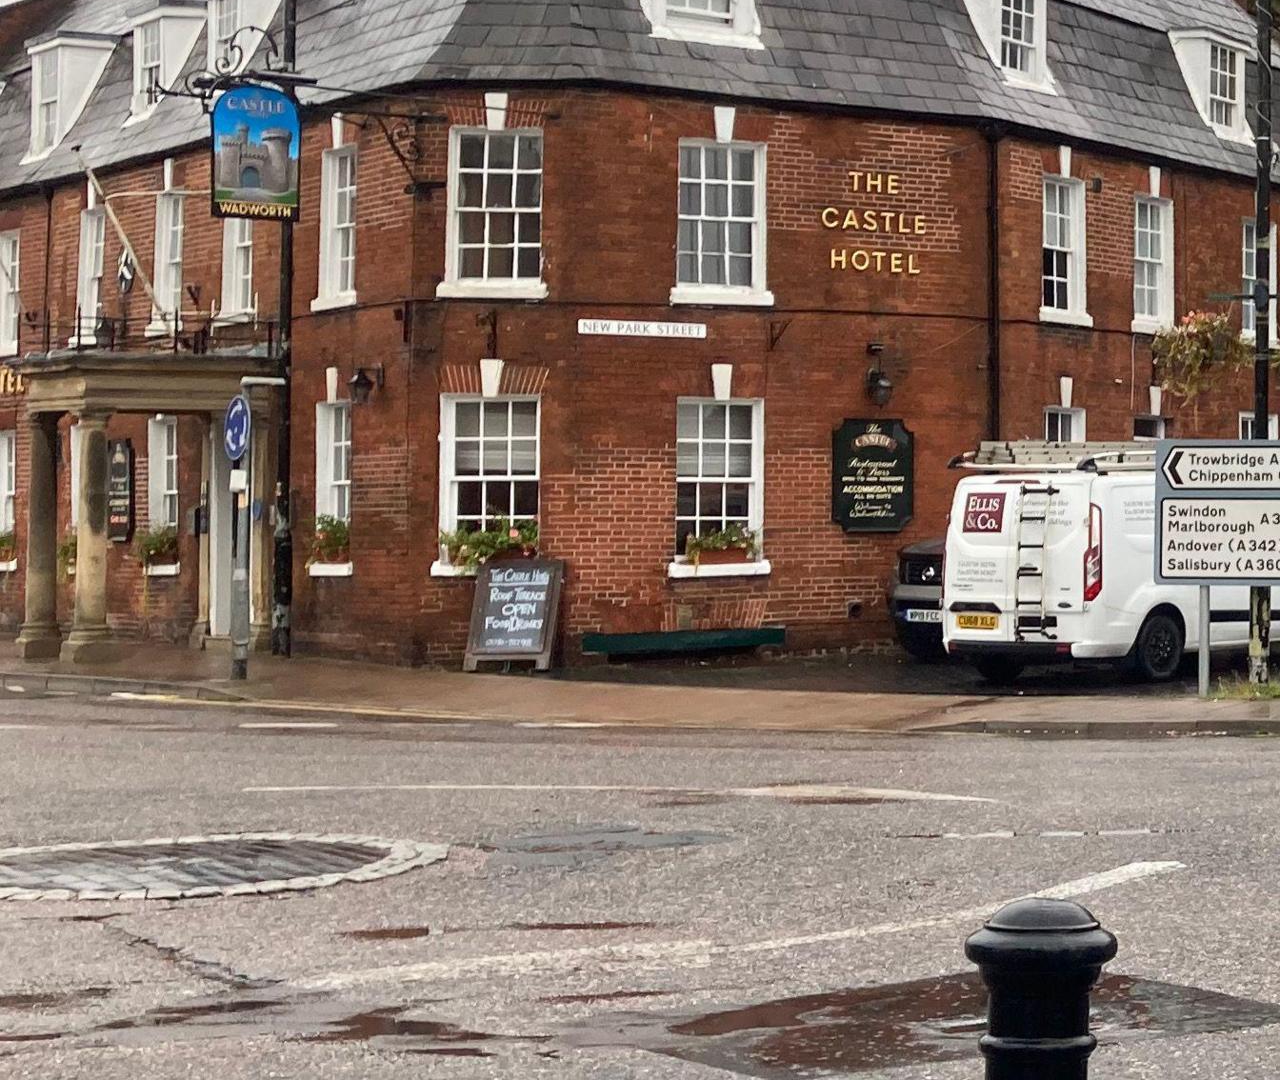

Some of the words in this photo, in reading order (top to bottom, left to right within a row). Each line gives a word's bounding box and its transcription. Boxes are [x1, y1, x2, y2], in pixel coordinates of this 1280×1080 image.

[848, 171, 900, 194] THE
[219, 202, 291, 217] WADWORTH
[821, 207, 926, 234] CASTLE
[830, 248, 921, 274] HOTEL
[582, 322, 611, 332] NEW
[617, 323, 650, 334] PARK
[656, 324, 702, 336] STREET
[1188, 453, 1265, 467] Trowbridge
[1188, 469, 1273, 483] Chippenham
[842, 485, 904, 493] ACCOMMODATION
[1168, 505, 1226, 517] Swindon
[1168, 521, 1255, 535] Marlborough
[1167, 539, 1224, 551] Andover
[1167, 559, 1231, 572] Salisbury
[502, 602, 537, 617] OPEN
